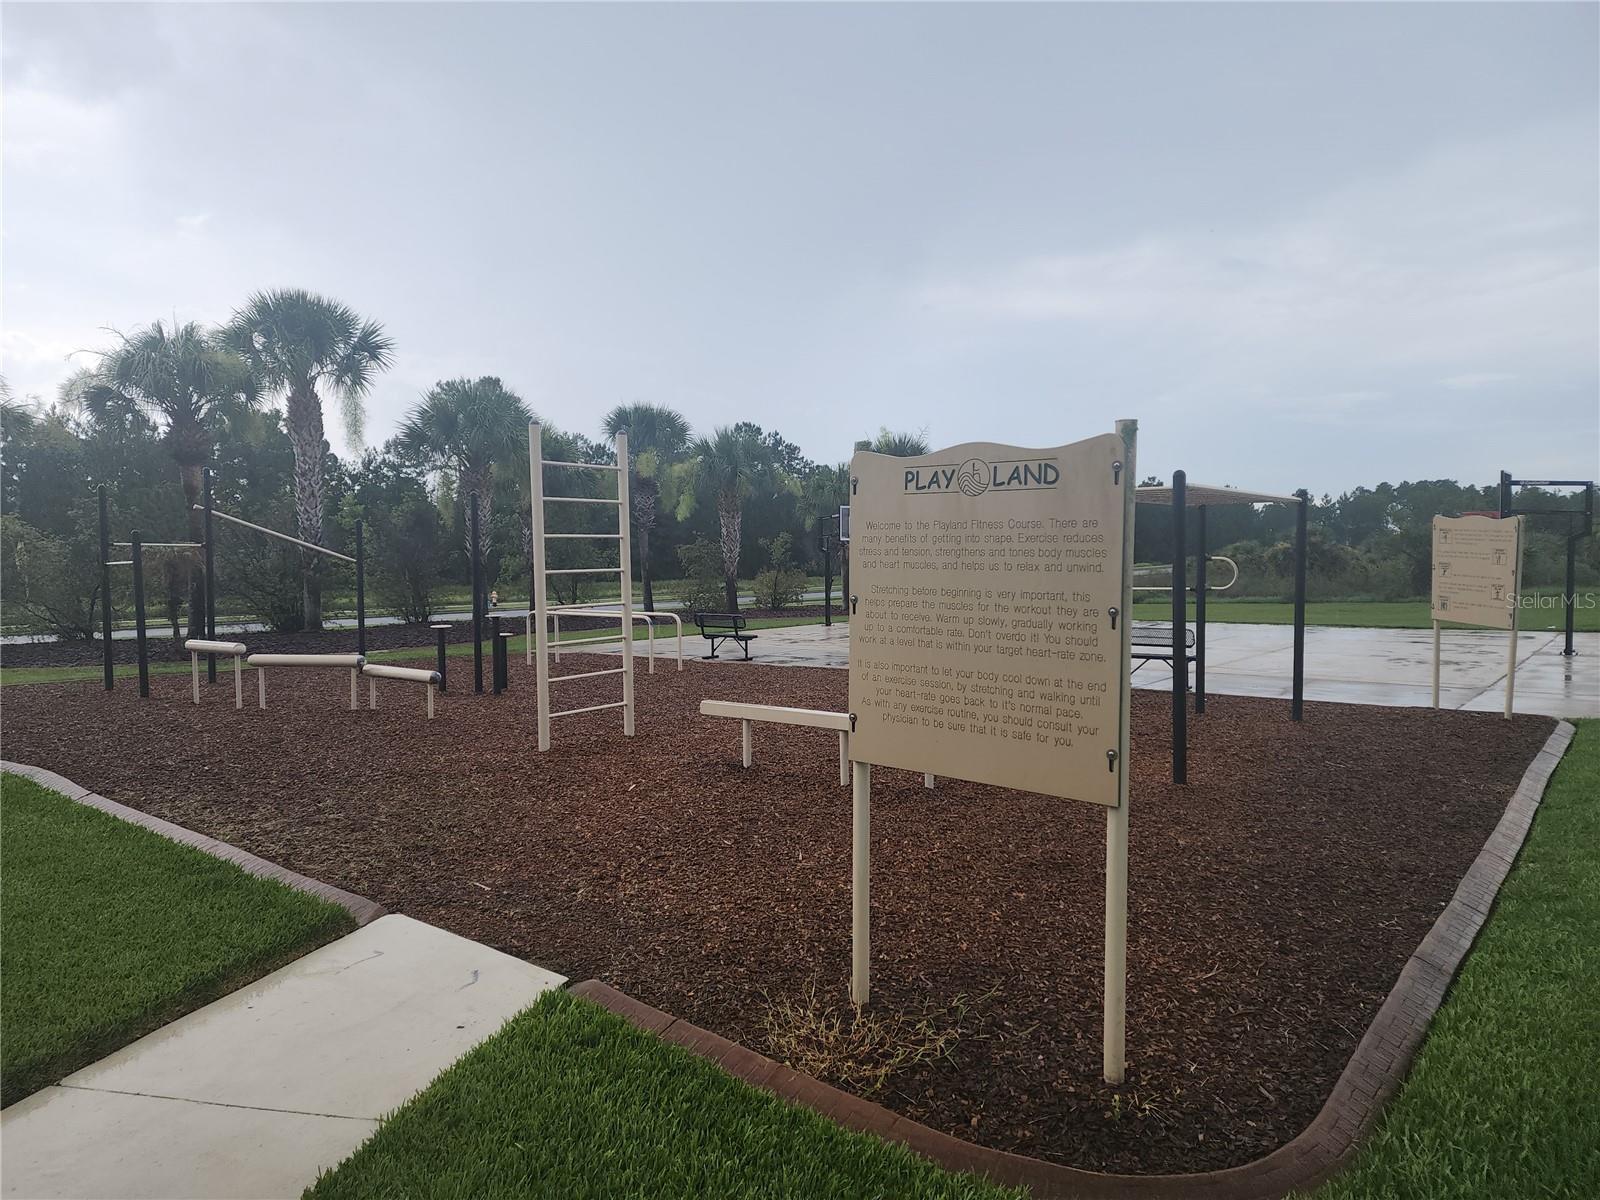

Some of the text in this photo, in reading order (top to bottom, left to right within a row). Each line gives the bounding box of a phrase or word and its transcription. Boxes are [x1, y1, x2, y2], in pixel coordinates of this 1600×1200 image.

[904, 463, 1060, 490] PLAY LAND
[866, 521, 900, 530] Welcome
[905, 521, 912, 530] to
[917, 521, 929, 529] the
[934, 520, 967, 531] Playland
[972, 520, 1004, 530] Fitness
[1048, 518, 1077, 528] There
[1082, 520, 1098, 528] are
[862, 535, 881, 544] many
[886, 534, 916, 543] benefits
[921, 534, 928, 543] of
[932, 534, 961, 545] getting
[965, 535, 980, 543] into
[1018, 533, 1058, 543] Exercise
[1063, 534, 1104, 543] reduces
[860, 548, 881, 556] stress
[885, 547, 898, 556] and
[935, 546, 986, 559] strengthens
[989, 548, 1005, 557] and
[1010, 548, 1035, 557] tones
[1038, 548, 1062, 560] body
[1066, 548, 1107, 558] muscles
[863, 560, 876, 568] and
[880, 560, 900, 568] heart
[942, 561, 957, 570] and
[962, 561, 984, 572] helps
[1004, 562, 1012, 571] to
[1017, 562, 1040, 571] relax
[1044, 562, 1062, 572] and
[871, 584, 908, 596] Stretching
[912, 586, 937, 596] before
[941, 587, 981, 599] beginning
[985, 589, 992, 598] is
[998, 590, 1016, 600] very
[1073, 592, 1090, 602] this
[865, 598, 1098, 618] helps prepare the muscles for the workout they are
[866, 610, 887, 619] about
[891, 611, 898, 620] to
[936, 613, 959, 623] Warm
[964, 616, 973, 625] up
[1012, 619, 1053, 631] gradually
[1059, 622, 1097, 634] working
[865, 623, 873, 631] up
[878, 623, 884, 632] to
[897, 625, 943, 636] comfortable
[968, 628, 991, 639] Don't
[996, 632, 1026, 641] overdo
[1044, 634, 1060, 644] You
[1065, 636, 1098, 647] should
[880, 636, 886, 644] at
[898, 637, 914, 646] level
[918, 638, 932, 648] that
[946, 641, 970, 651] within
[973, 644, 992, 654] your
[997, 645, 1022, 656] target
[858, 659, 861, 667] It
[874, 662, 888, 670] also
[892, 663, 928, 674] important
[932, 665, 939, 675] to
[943, 666, 952, 676] let
[956, 670, 973, 679] your
[978, 670, 999, 683] body
[1002, 673, 1022, 683] cool
[1026, 675, 1050, 686] down
[1054, 678, 1062, 687] at
[1067, 679, 1083, 689] the
[1088, 681, 1106, 692] end
[862, 672, 869, 680] of
[885, 675, 916, 685] exercise
[957, 682, 967, 693] by
[970, 683, 1014, 698] stretching
[1018, 689, 1034, 699] and
[1040, 691, 1076, 705] walking
[1080, 694, 1100, 706] until
[876, 687, 891, 696] your
[940, 694, 960, 704] goes
[964, 695, 984, 706] back
[990, 699, 998, 708] to
[1002, 700, 1016, 711] it's
[1020, 704, 1052, 715] normal
[862, 697, 871, 705] As
[875, 698, 890, 708] with
[894, 702, 907, 712] any
[911, 703, 943, 715] exercise
[984, 712, 998, 723] you
[1003, 714, 1032, 727] should
[1037, 719, 1072, 732] consult
[1078, 725, 1099, 736] your
[882, 712, 918, 724] physician
[922, 717, 929, 726] to
[934, 719, 943, 728] be
[948, 722, 965, 731] sure
[970, 723, 986, 735] that
[991, 725, 996, 736] it
[1001, 728, 1007, 737] is
[1012, 730, 1031, 740] safe
[1036, 733, 1049, 743] for
